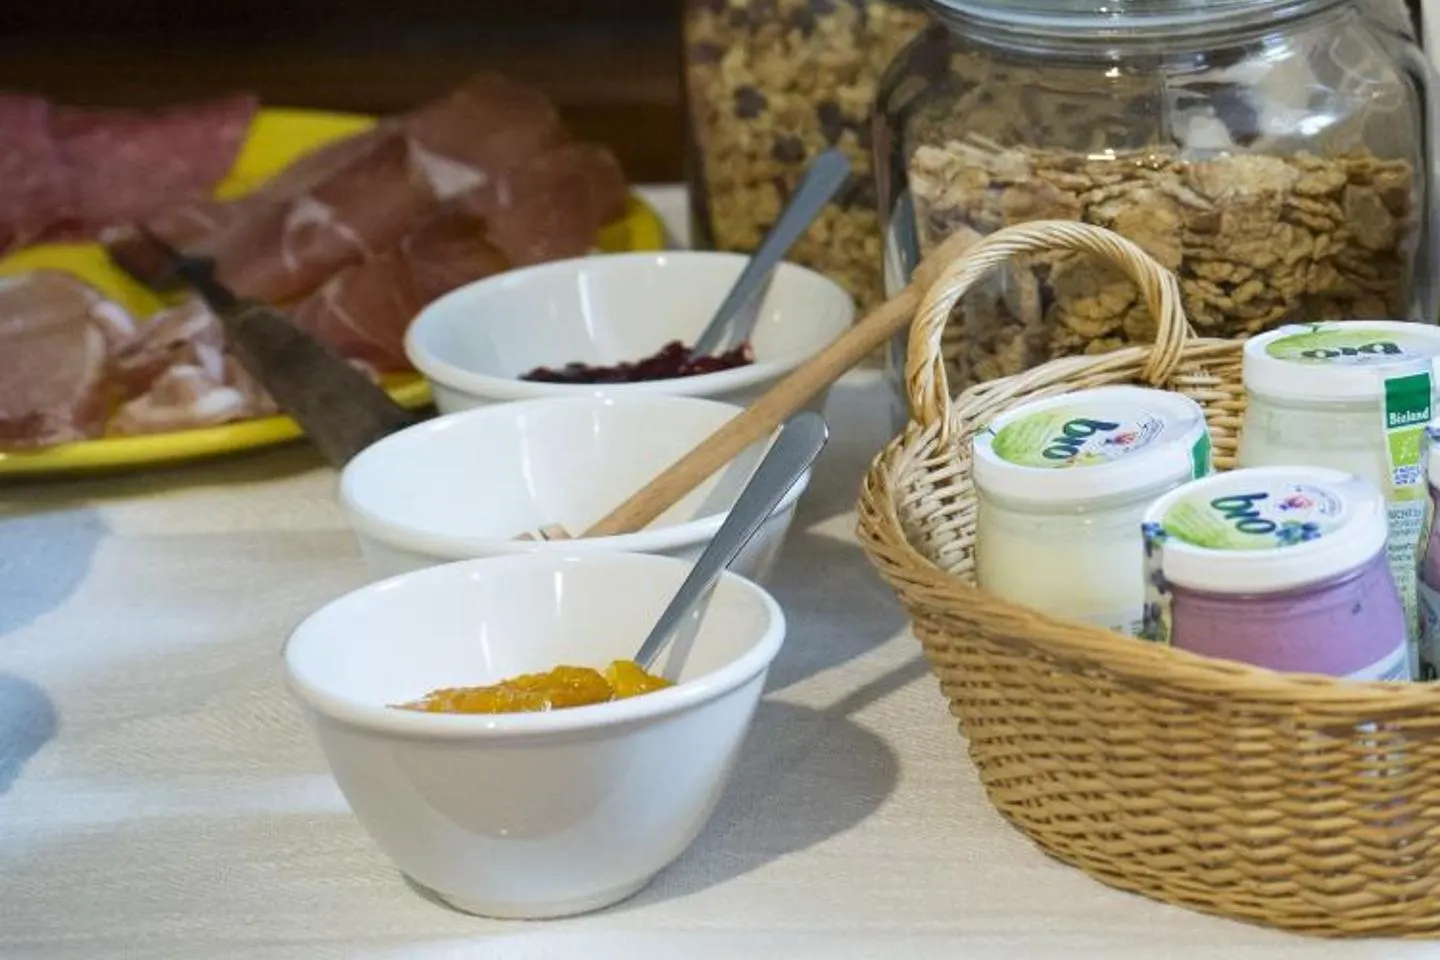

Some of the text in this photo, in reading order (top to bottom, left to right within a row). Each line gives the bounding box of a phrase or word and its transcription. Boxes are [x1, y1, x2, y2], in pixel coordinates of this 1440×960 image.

[1388, 407, 1430, 426] Bioland
[1042, 418, 1119, 460] bio
[1210, 492, 1277, 535] bio
